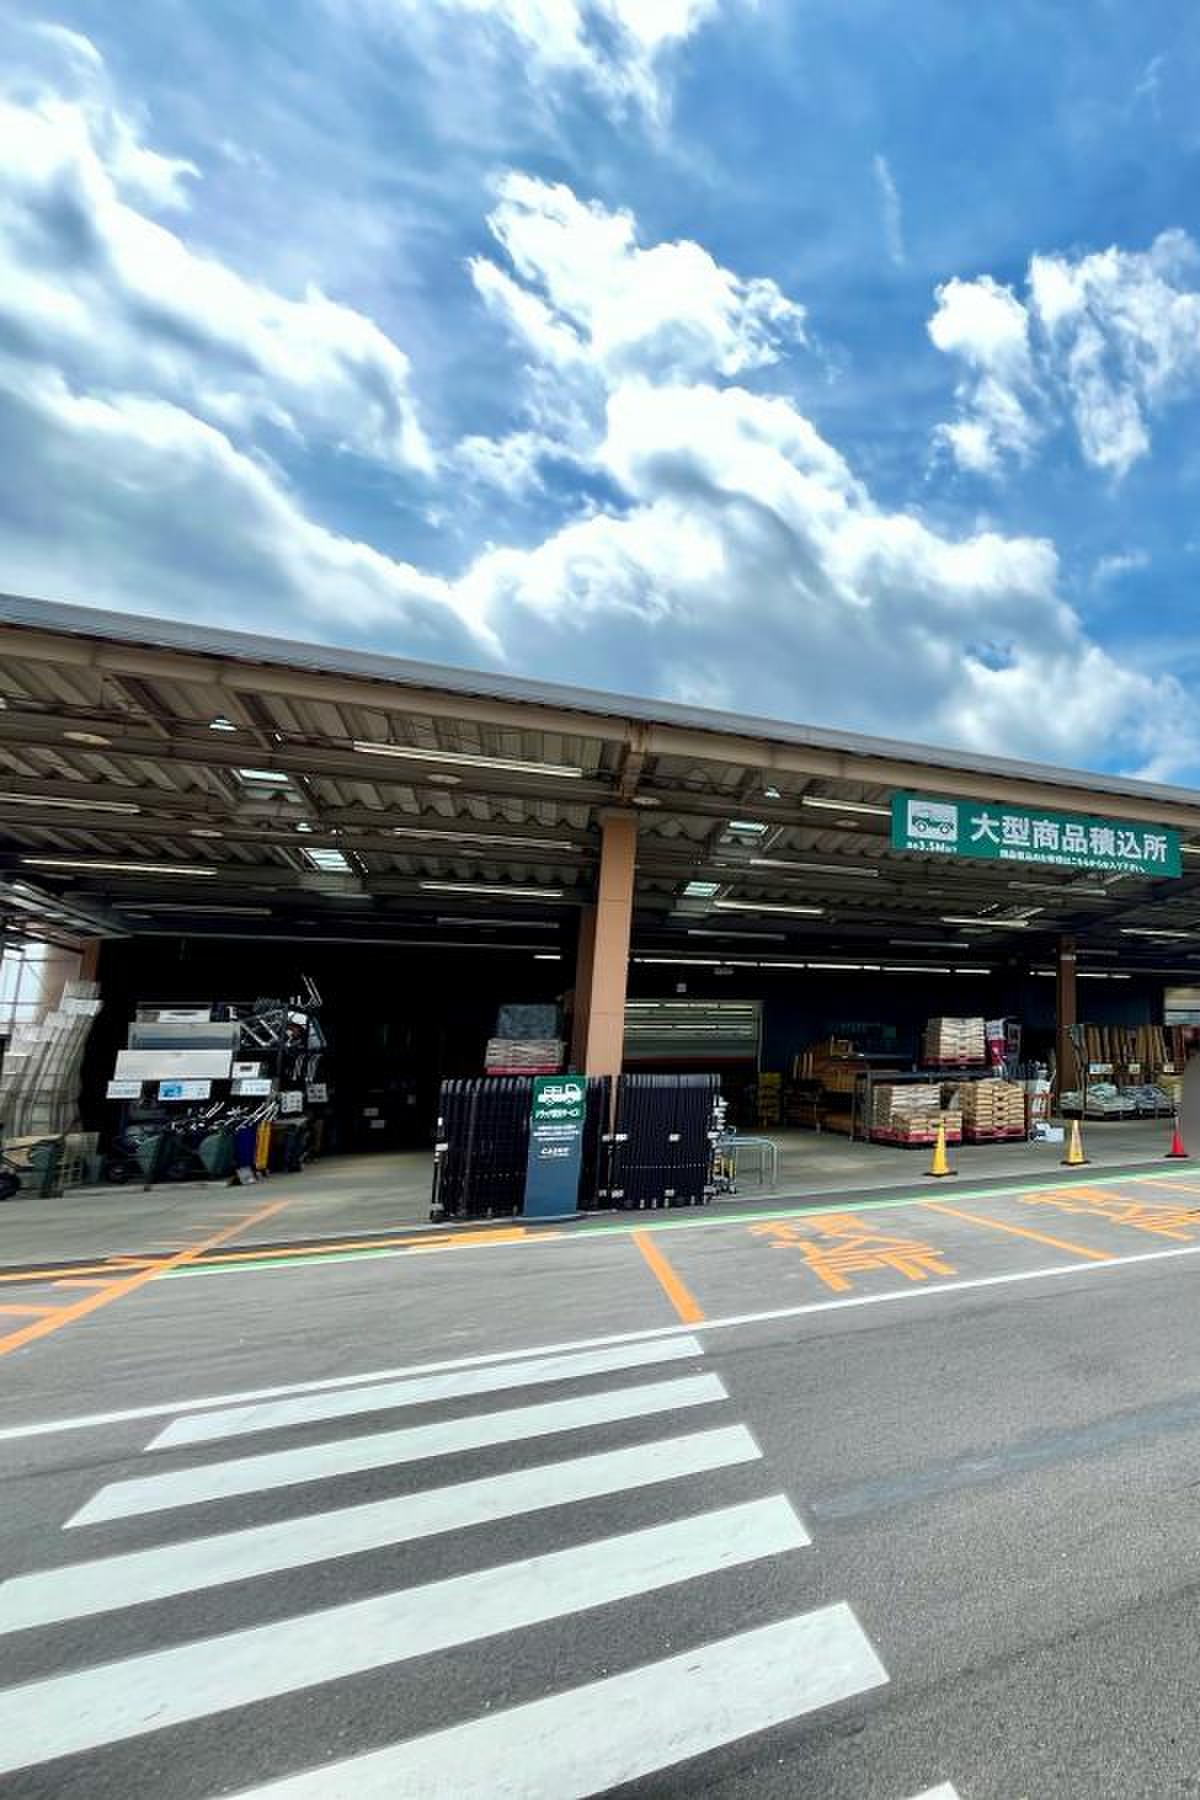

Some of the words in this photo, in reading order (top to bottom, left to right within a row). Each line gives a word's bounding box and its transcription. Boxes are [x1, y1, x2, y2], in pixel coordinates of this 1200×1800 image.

[970, 812, 1168, 862] 大型商品積込所
